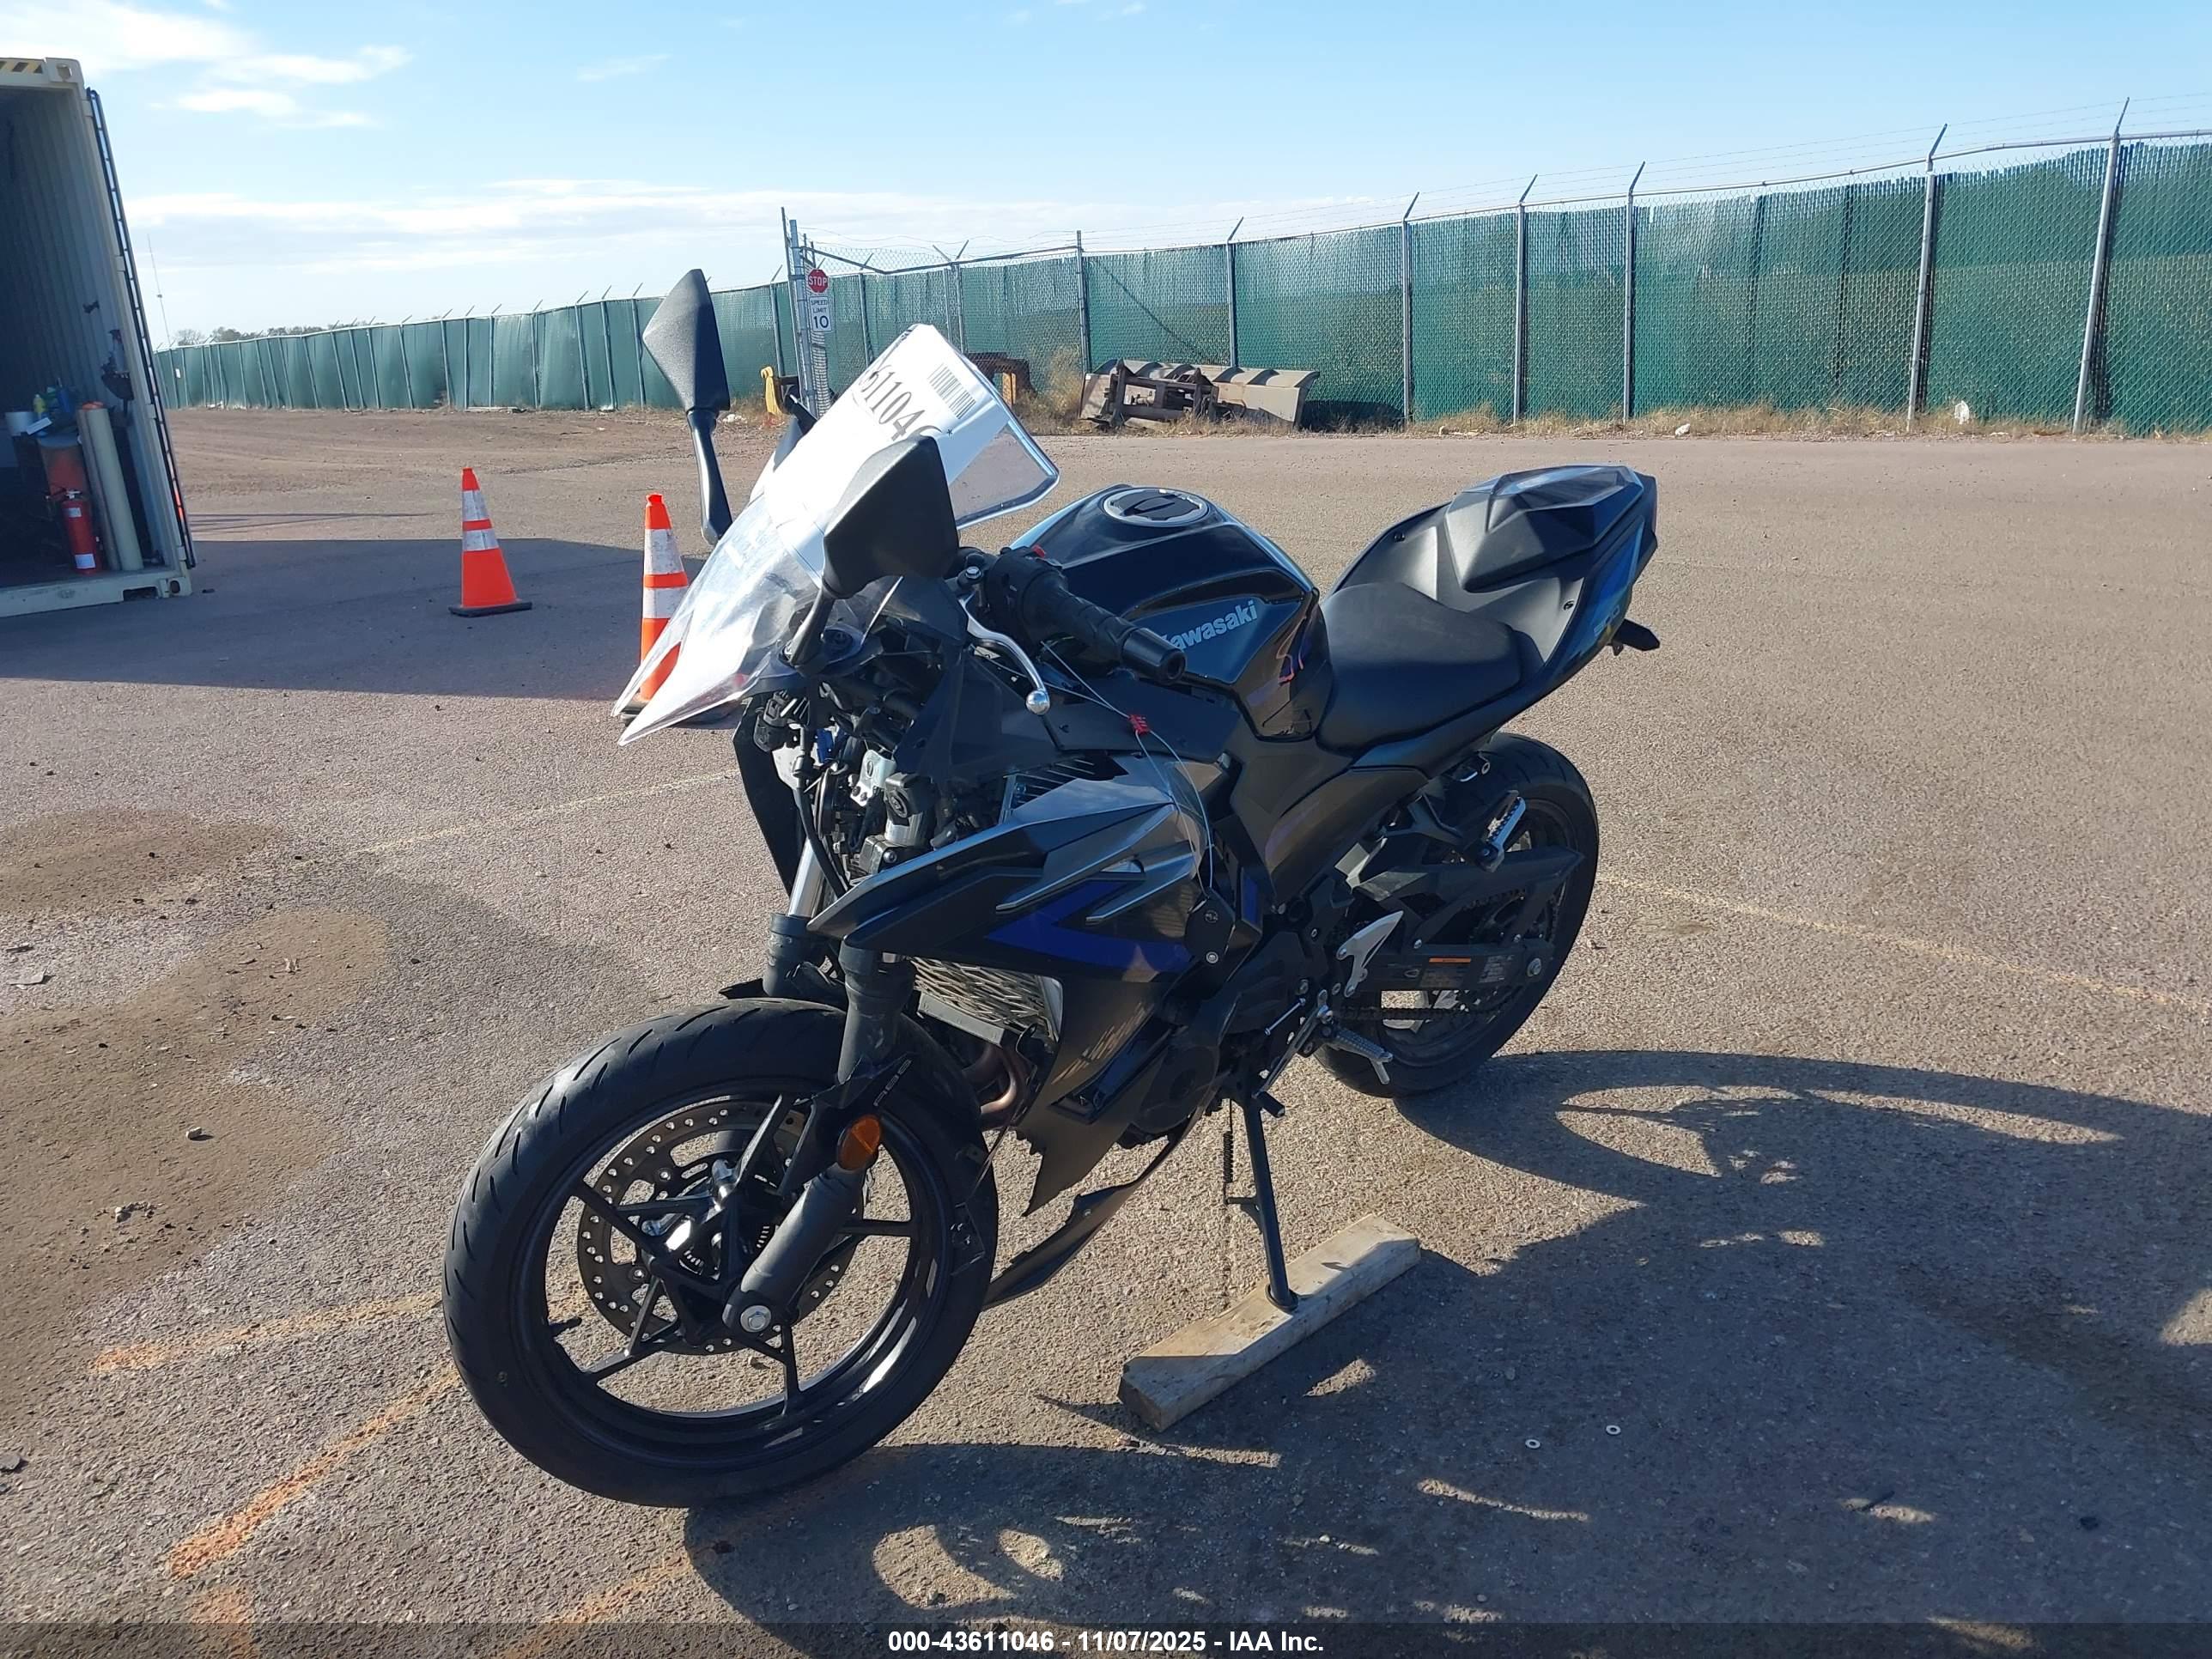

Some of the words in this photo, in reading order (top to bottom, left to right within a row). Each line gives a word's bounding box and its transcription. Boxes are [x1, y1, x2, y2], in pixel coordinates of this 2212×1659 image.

[808, 276, 828, 287] STOP
[813, 315, 829, 328] 10
[1160, 599, 1258, 651] awasaki
[872, 1059, 912, 1107] ABS
